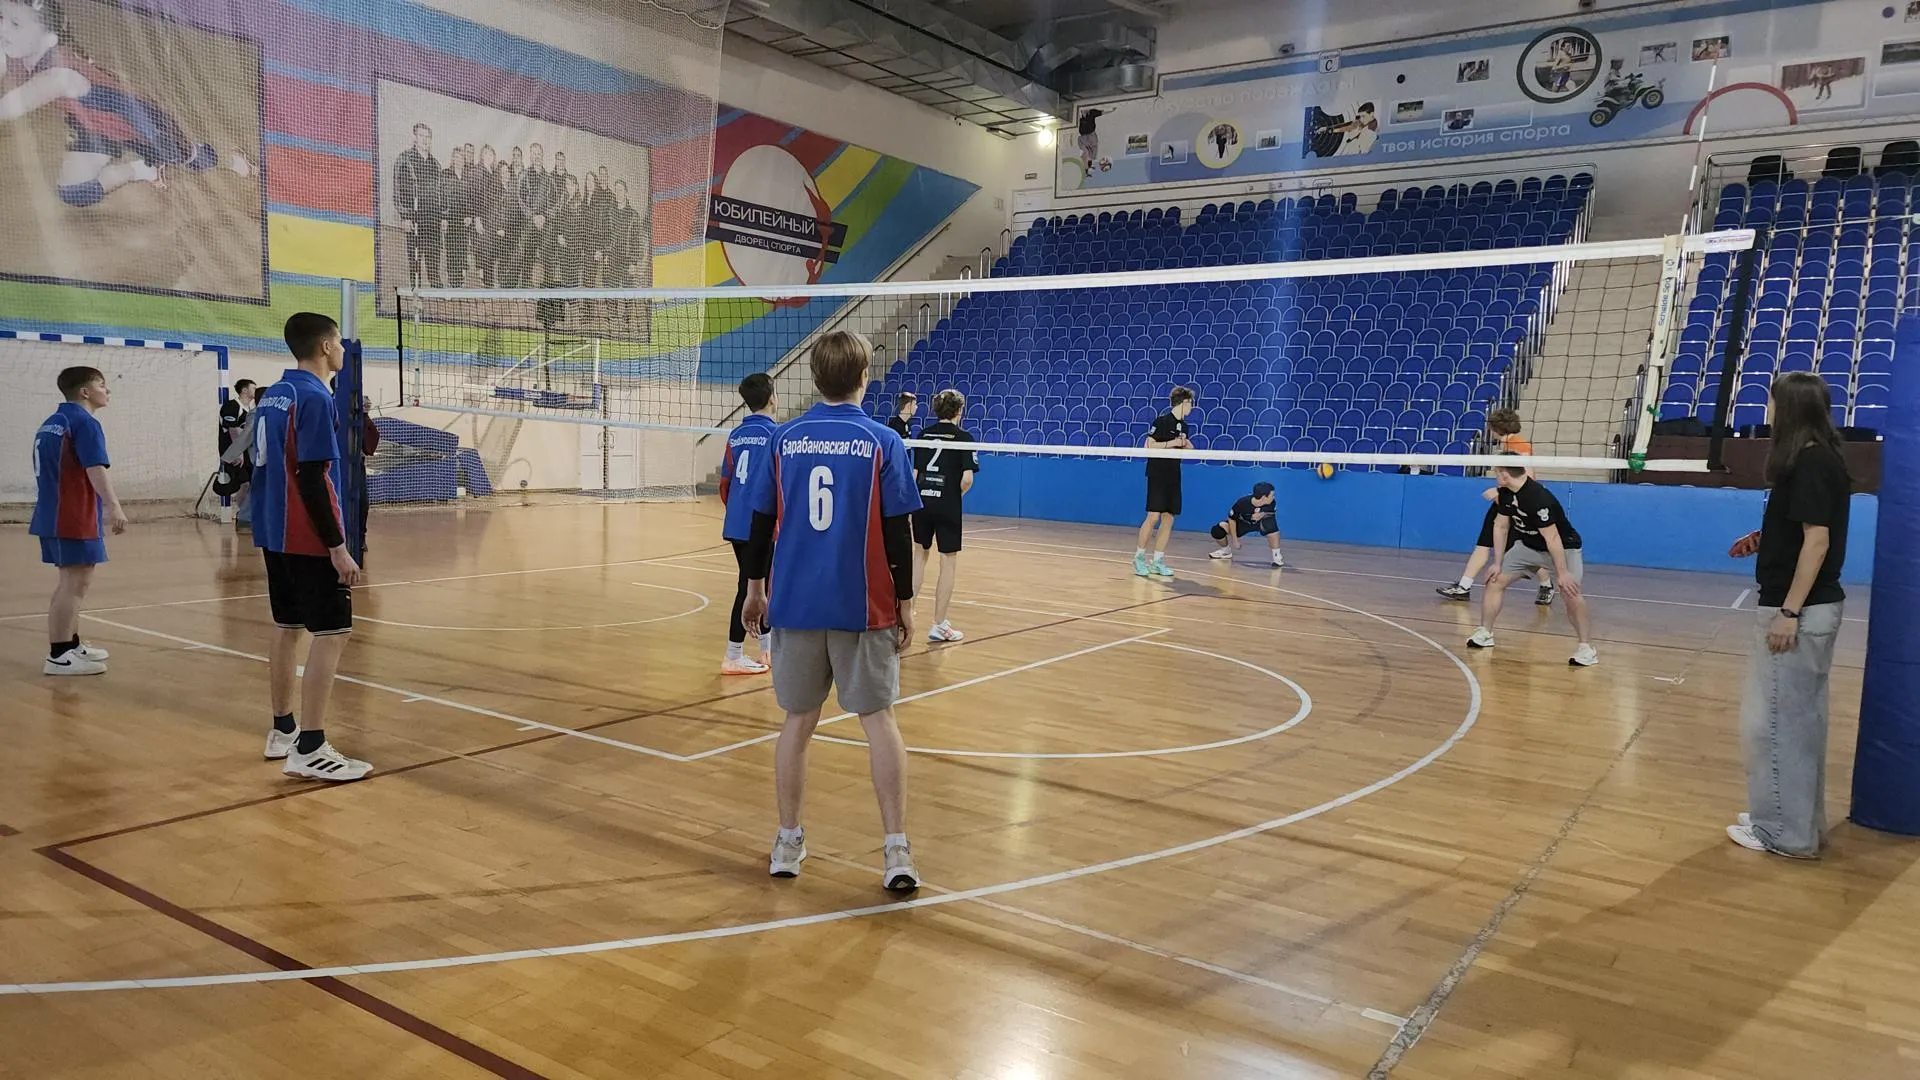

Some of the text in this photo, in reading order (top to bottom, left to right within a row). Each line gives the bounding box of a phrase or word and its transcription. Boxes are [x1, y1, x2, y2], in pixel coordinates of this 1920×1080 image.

[1382, 123, 1571, 153] твоя история спорта
[714, 200, 815, 236] ЮБИЛЕЙНЫЙ
[734, 234, 802, 254] ДВОРЕЦ СПОРТА
[782, 436, 873, 458] Барабановская СОШ
[736, 449, 750, 485] 4
[808, 465, 834, 532] 6
